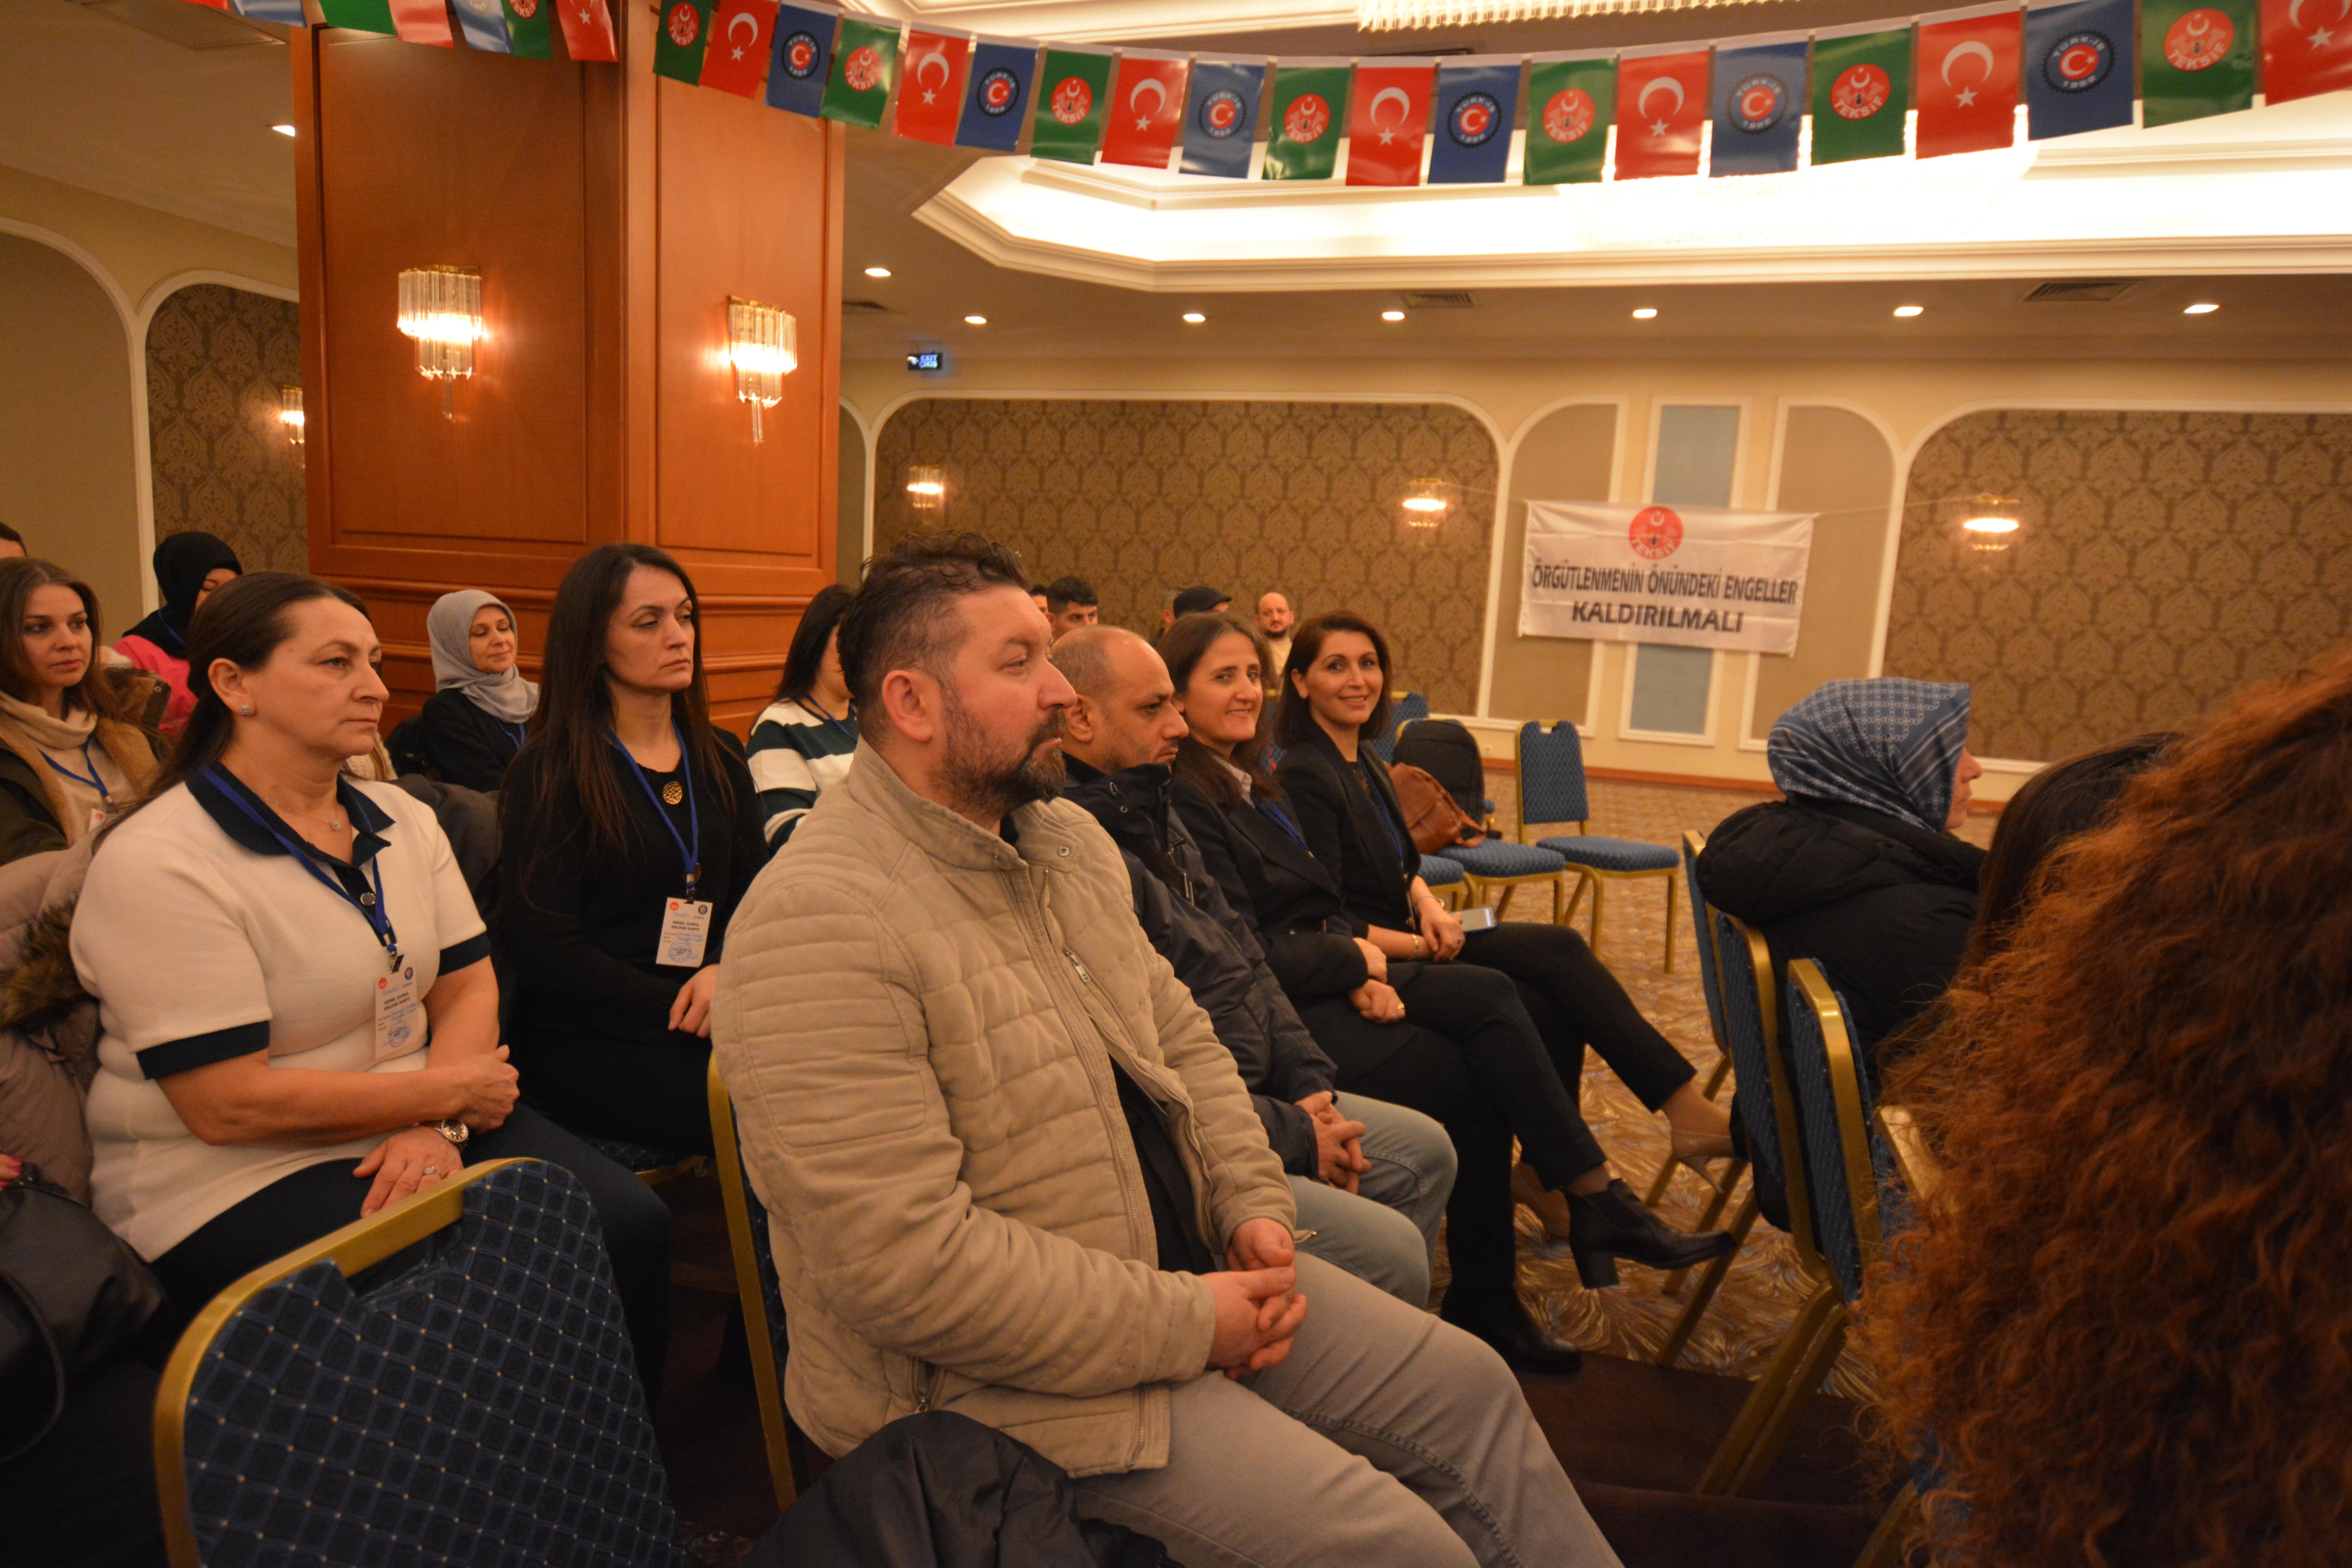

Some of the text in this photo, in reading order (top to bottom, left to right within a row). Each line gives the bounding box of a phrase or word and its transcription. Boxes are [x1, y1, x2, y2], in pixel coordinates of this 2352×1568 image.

[1532, 558, 1799, 604] ÖRGÜTLENMENİN ÖNÜNDEKİ ENGELLER
[1572, 600, 1744, 633] KALDIRILMALI
